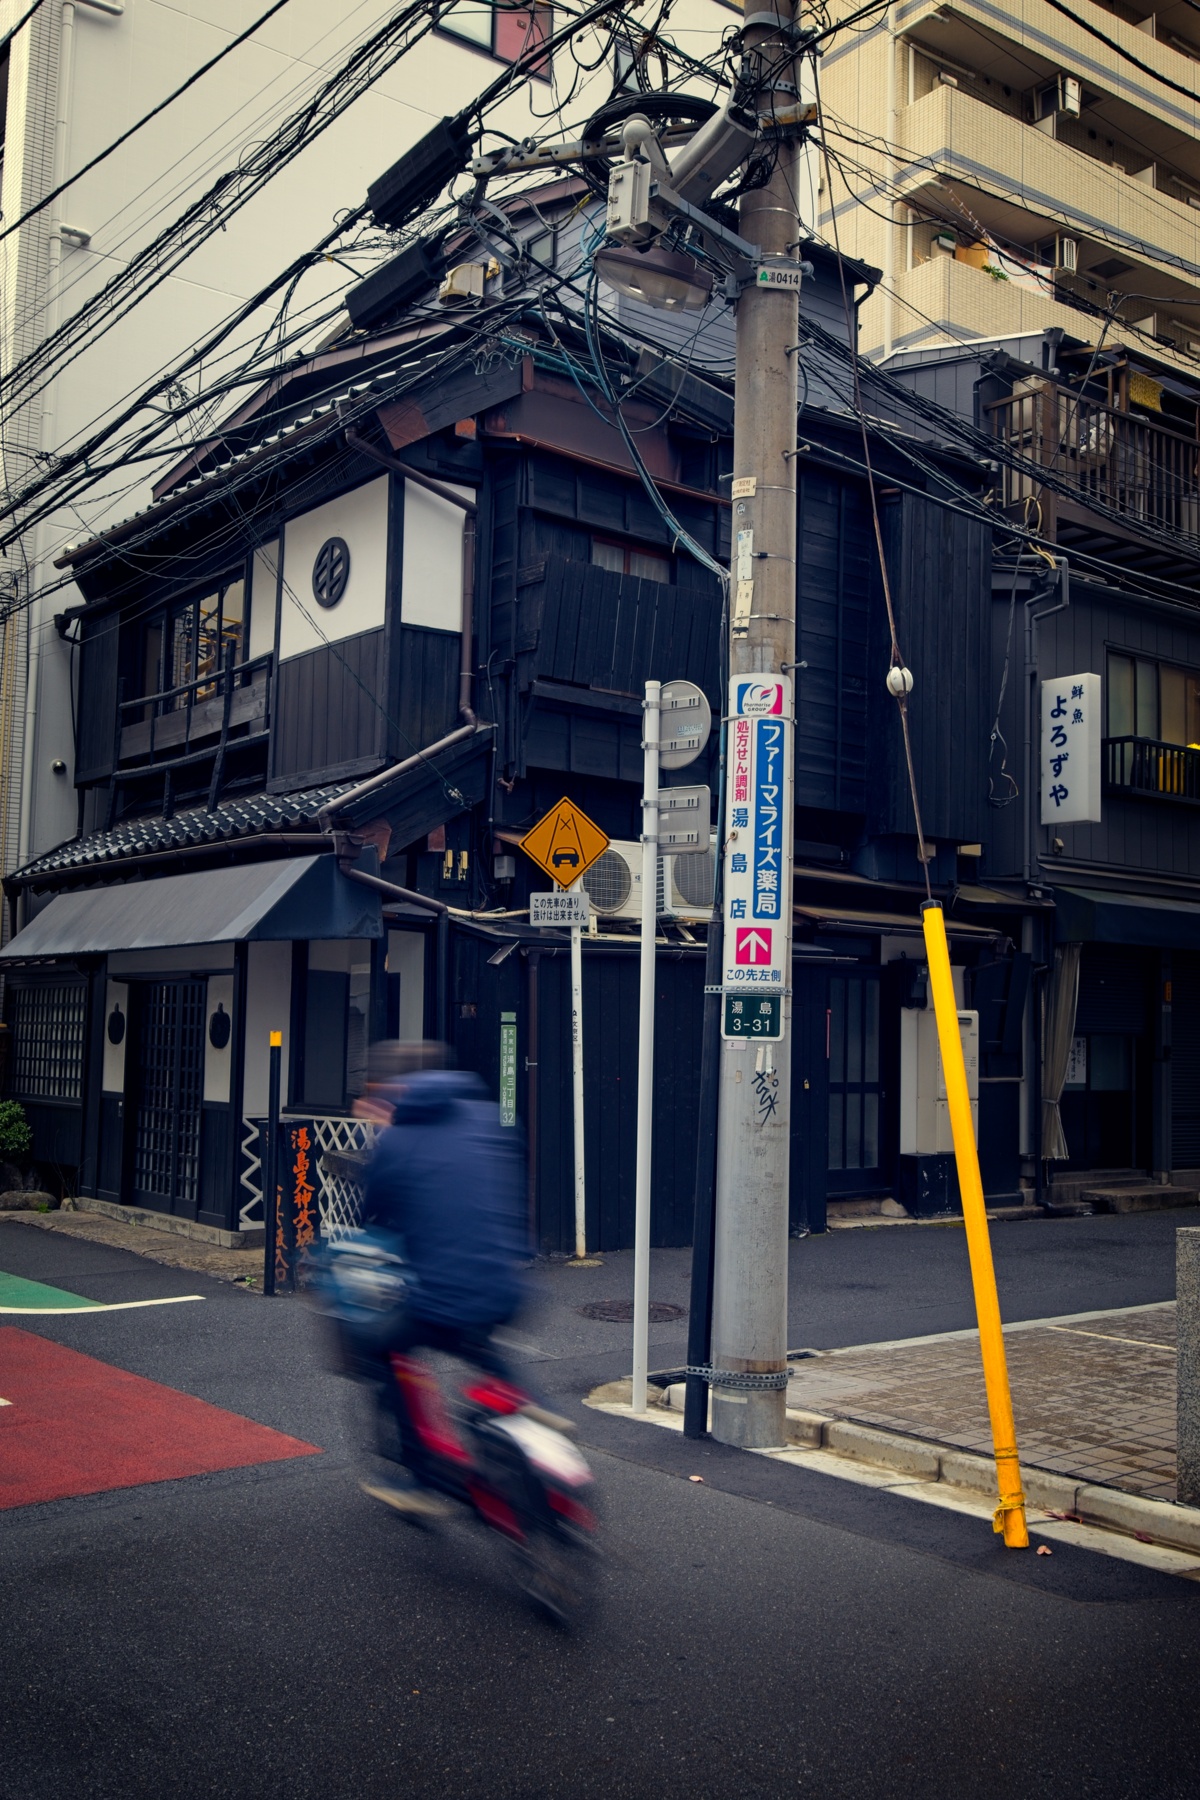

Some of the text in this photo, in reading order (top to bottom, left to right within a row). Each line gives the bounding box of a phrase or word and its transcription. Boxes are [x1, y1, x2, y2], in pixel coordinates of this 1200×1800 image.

[1071, 684, 1084, 725] 鮮魚
[1049, 695, 1069, 807] よろずや
[735, 720, 749, 802] 処方せん調剤
[755, 725, 781, 915] ファーマライズ薬局
[533, 897, 580, 909] この先車の通り
[533, 910, 587, 921] 抜けは出来ません
[726, 969, 781, 982] この先左側
[732, 1001, 777, 1015] 湯島
[733, 1018, 770, 1032] 3-31
[502, 1112, 514, 1124] 32
